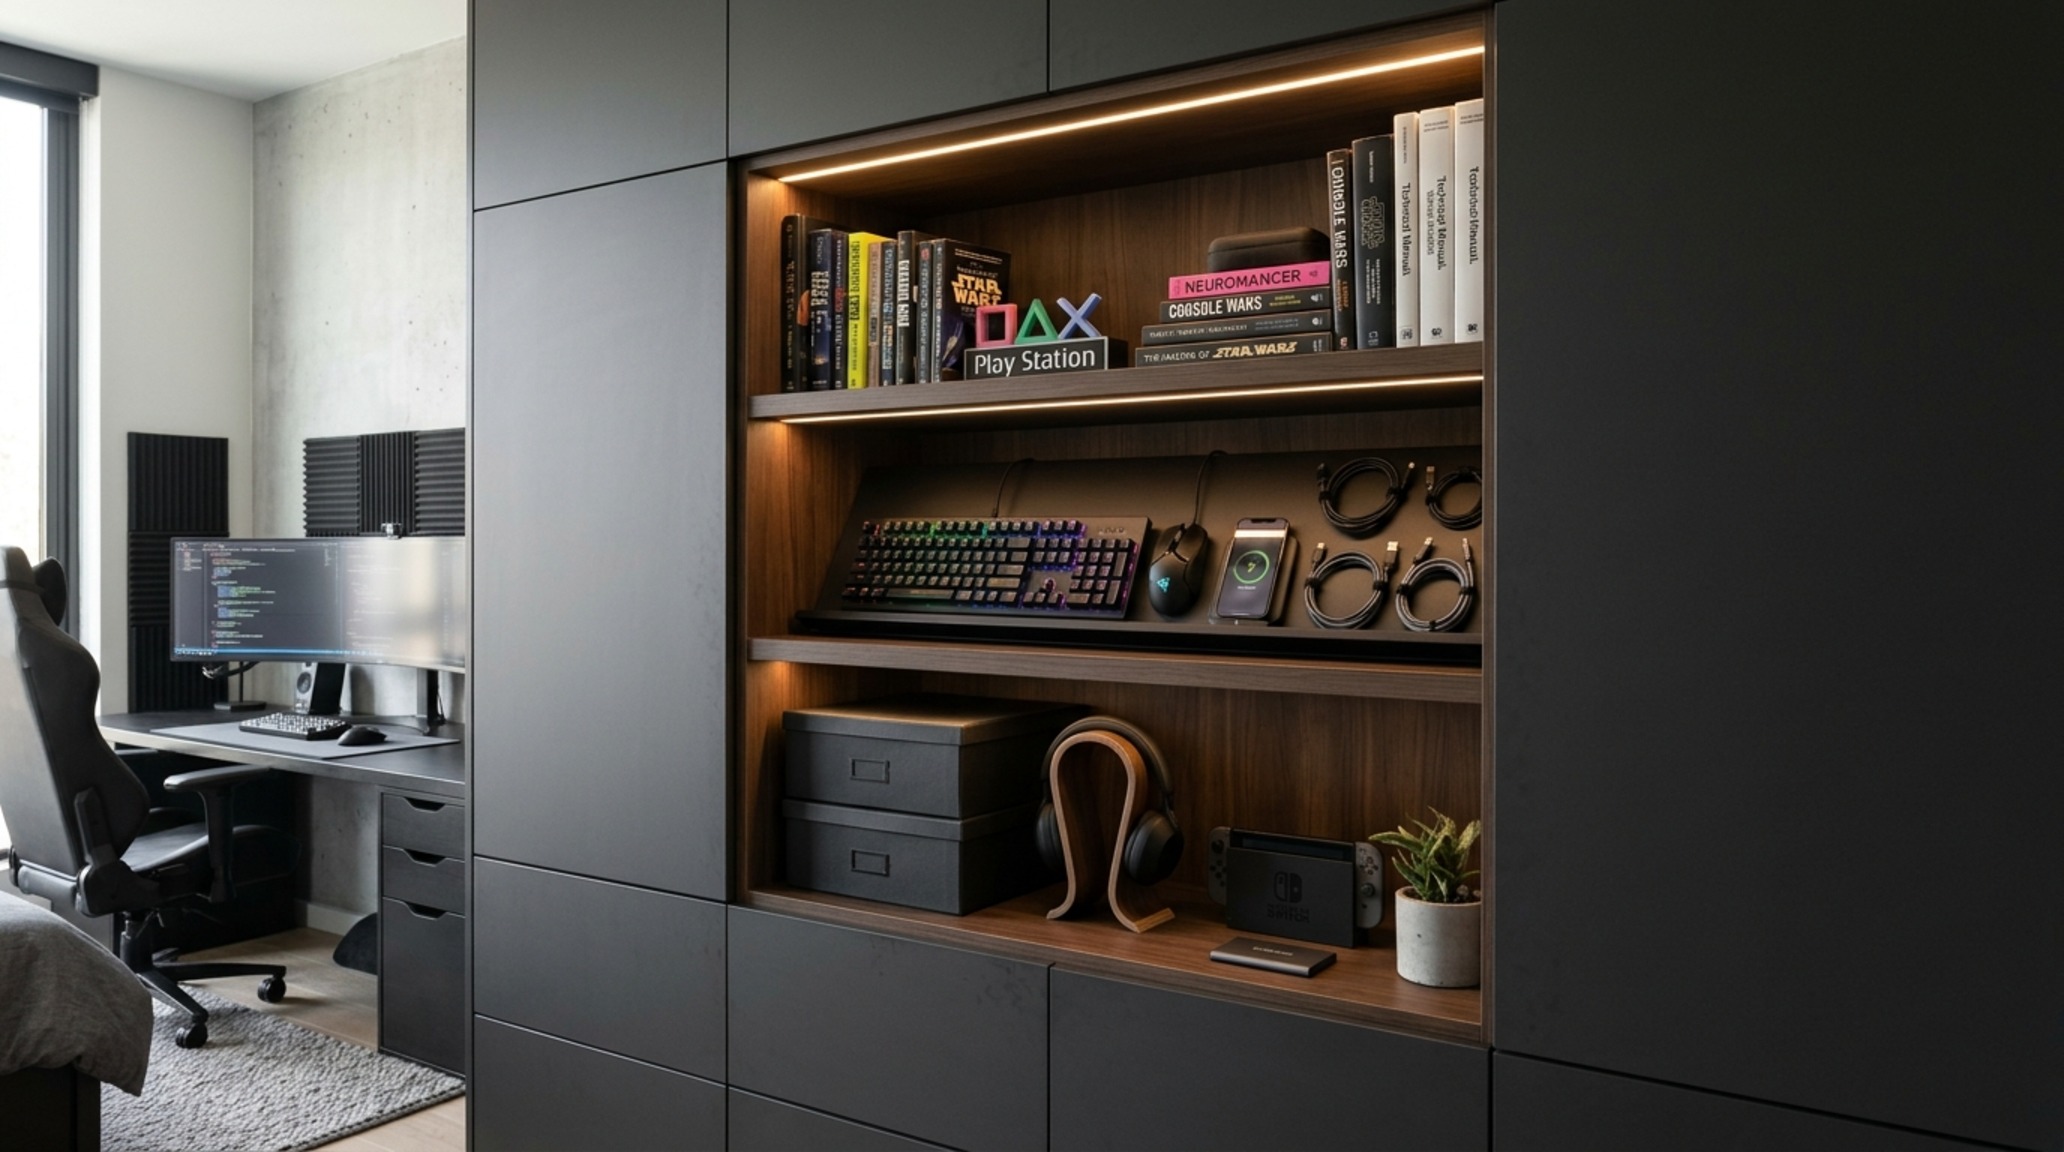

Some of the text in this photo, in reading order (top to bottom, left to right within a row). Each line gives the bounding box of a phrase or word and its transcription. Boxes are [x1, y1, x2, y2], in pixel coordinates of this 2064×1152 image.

[951, 273, 1002, 296] STAR
[1184, 269, 1301, 294] NEUROMANCER
[974, 348, 1096, 377] Play Station
